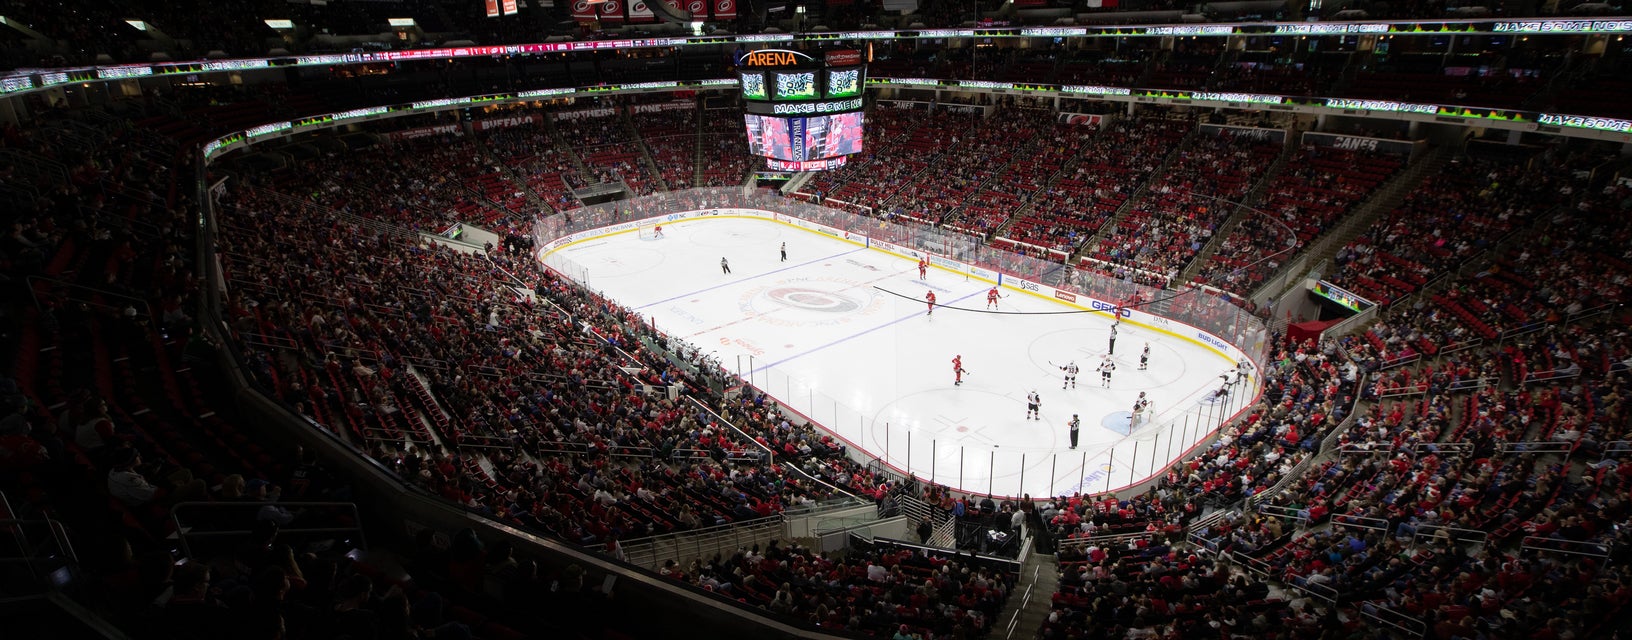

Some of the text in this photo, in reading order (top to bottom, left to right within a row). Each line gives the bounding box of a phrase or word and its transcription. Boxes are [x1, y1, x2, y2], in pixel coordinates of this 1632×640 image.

[1493, 22, 1541, 32] MAKE
[1541, 21, 1592, 31] SOME
[748, 50, 797, 66] ARENA
[635, 104, 662, 113] ZONE
[774, 103, 815, 113] MAKE
[816, 101, 850, 111] SOME
[558, 108, 615, 120] BROTHERS
[482, 116, 533, 129] BUFFALO
[1538, 114, 1631, 130] MAKE SOME
[1333, 136, 1379, 150] CANES
[870, 239, 883, 247] BULLY
[1026, 282, 1039, 291] sas
[1056, 292, 1075, 301] Lenovo
[1198, 333, 1228, 351] BUD LIGHT
